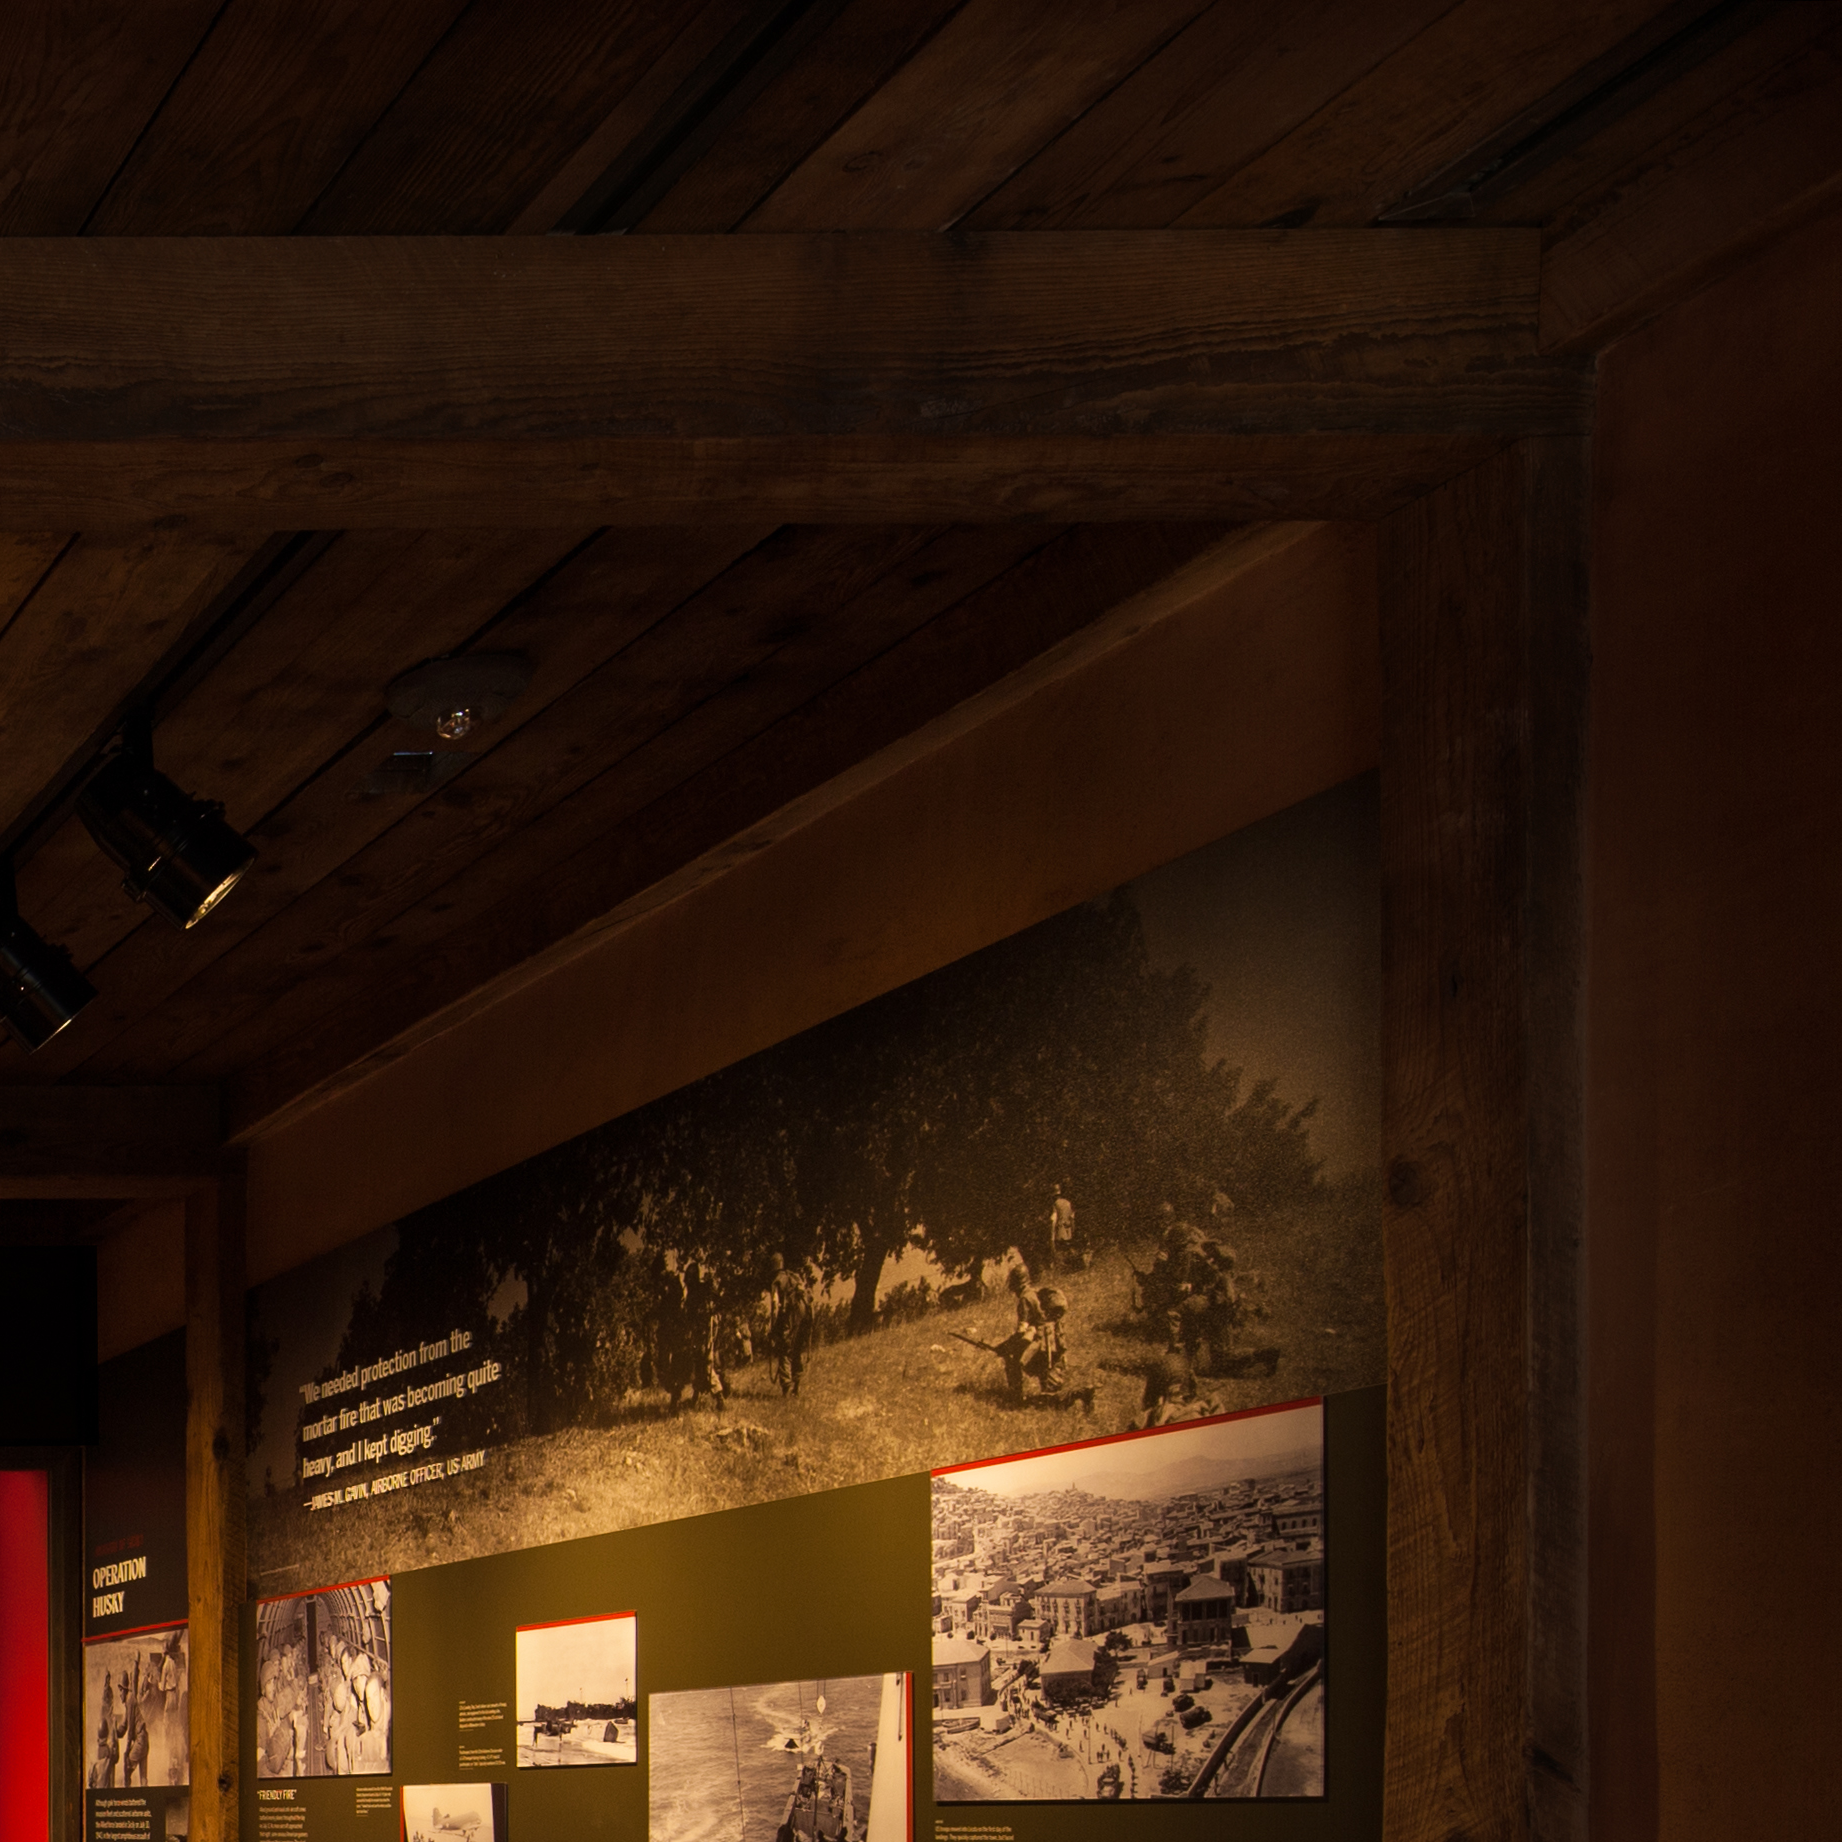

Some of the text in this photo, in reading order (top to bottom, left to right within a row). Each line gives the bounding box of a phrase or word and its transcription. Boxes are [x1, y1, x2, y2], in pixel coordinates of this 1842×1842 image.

[321, 1366, 359, 1398] needed
[361, 1350, 417, 1390] protection
[420, 1340, 448, 1364] from
[450, 1328, 472, 1352] the
[303, 1360, 501, 1442] mortar fire that was becoming quite
[303, 1456, 334, 1479] heavy,
[336, 1443, 357, 1469] and
[358, 1441, 362, 1462] I
[364, 1434, 388, 1463] kept
[345, 1482, 369, 1502] GAVIN,
[371, 1473, 408, 1496] AIRBORNE
[410, 1462, 445, 1486] OFFICER,
[447, 1458, 460, 1475] US
[461, 1450, 486, 1472] ARMY
[93, 1556, 146, 1590] OPERATION
[93, 1591, 125, 1618] HUSKY
